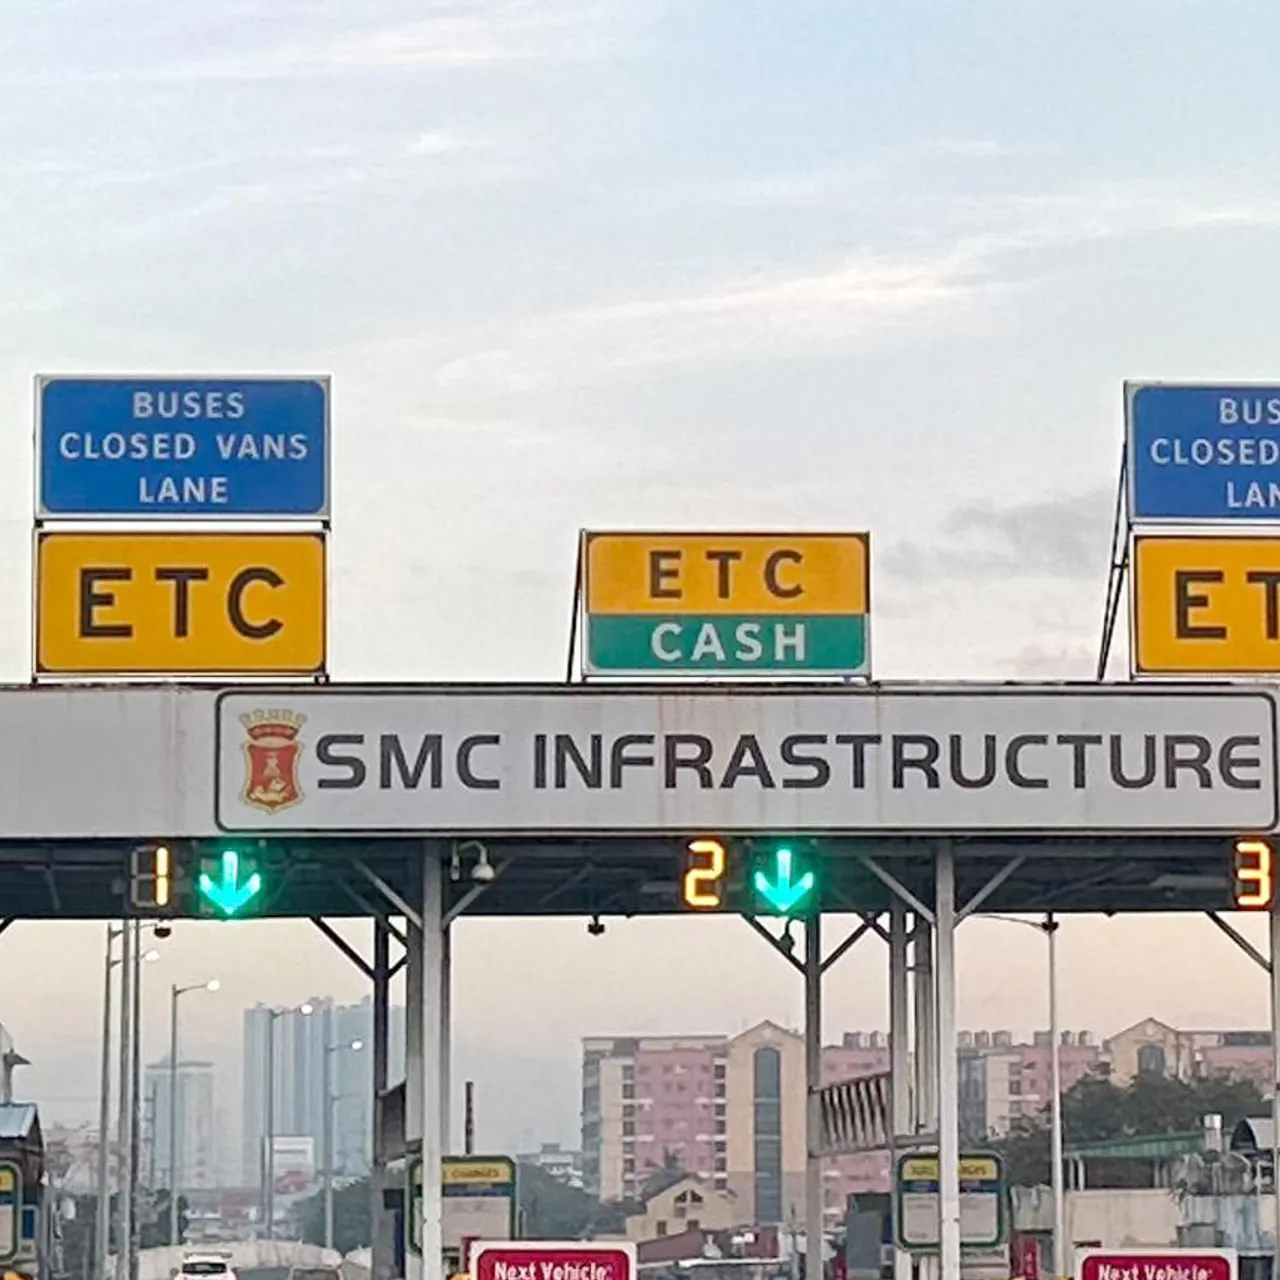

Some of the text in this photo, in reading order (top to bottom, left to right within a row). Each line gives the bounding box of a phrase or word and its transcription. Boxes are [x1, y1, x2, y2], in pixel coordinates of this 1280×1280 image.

[133, 391, 245, 419] BUSES
[59, 432, 308, 460] CLOSED VANS
[1150, 438, 1280, 466] CLOSED
[139, 476, 229, 504] LANE
[649, 549, 806, 599] ETC
[78, 566, 286, 640] ETC
[650, 622, 807, 662] CASH
[315, 734, 1262, 790] SMC INFRASTRUCTURE
[155, 847, 169, 906] 1
[685, 841, 724, 907] 2
[1236, 841, 1272, 907] 3
